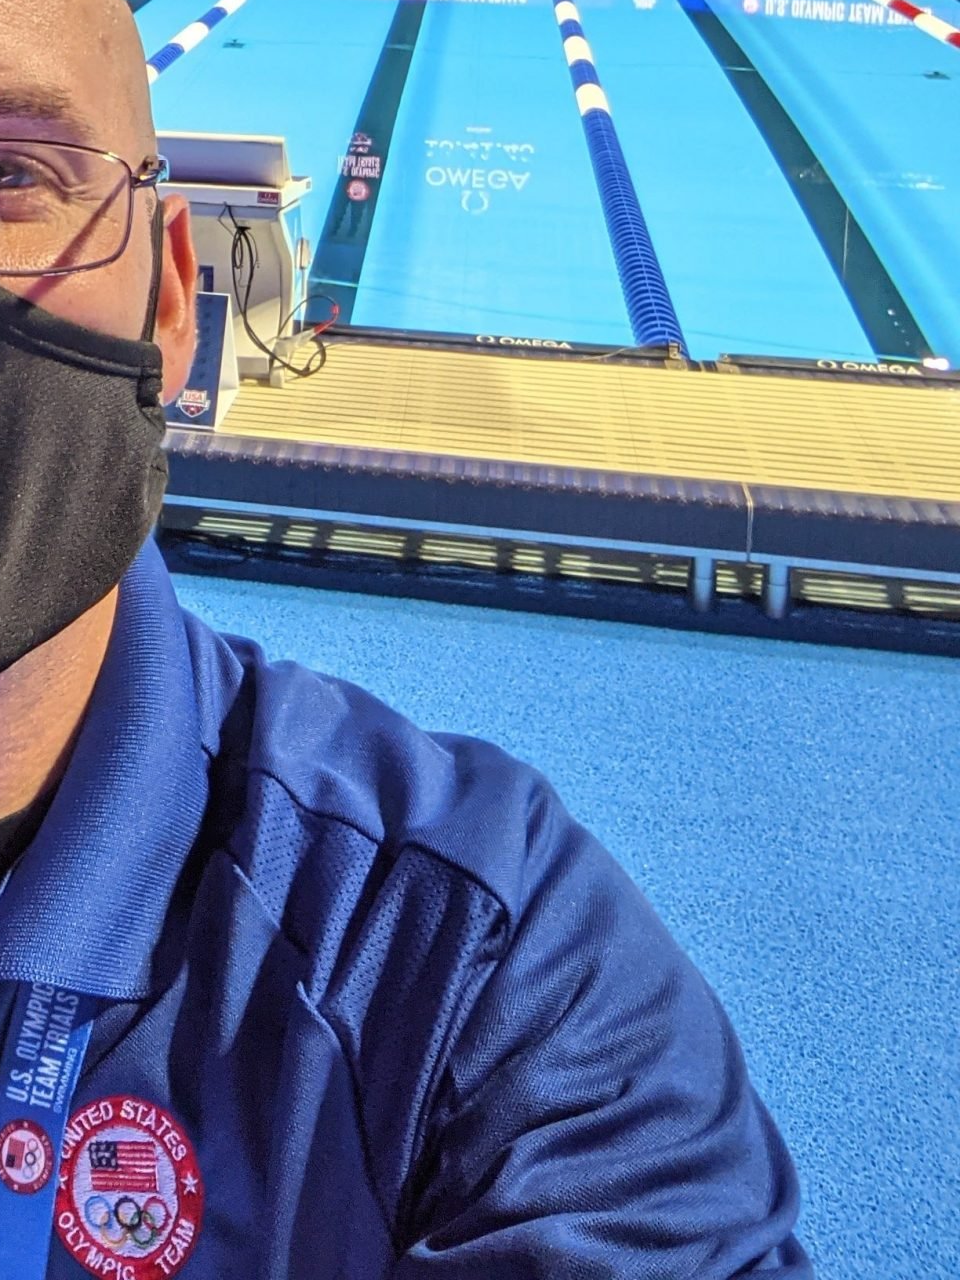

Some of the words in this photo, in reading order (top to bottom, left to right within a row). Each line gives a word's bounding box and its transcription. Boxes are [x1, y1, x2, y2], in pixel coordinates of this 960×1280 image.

[499, 336, 574, 351] OMEGA
[841, 361, 923, 377] OMEGA
[184, 392, 203, 402] USA
[15, 980, 57, 1062] OLYMPIC
[43, 990, 80, 1055] TRIALS
[6, 1066, 35, 1103] U.S.
[29, 1055, 62, 1109] TEAM
[53, 1046, 78, 1114] SWIMMING
[60, 1100, 114, 1160] UNITED
[119, 1099, 188, 1162] STATES
[58, 1210, 135, 1280] OLYMPIC
[154, 1218, 195, 1276] TEAM
